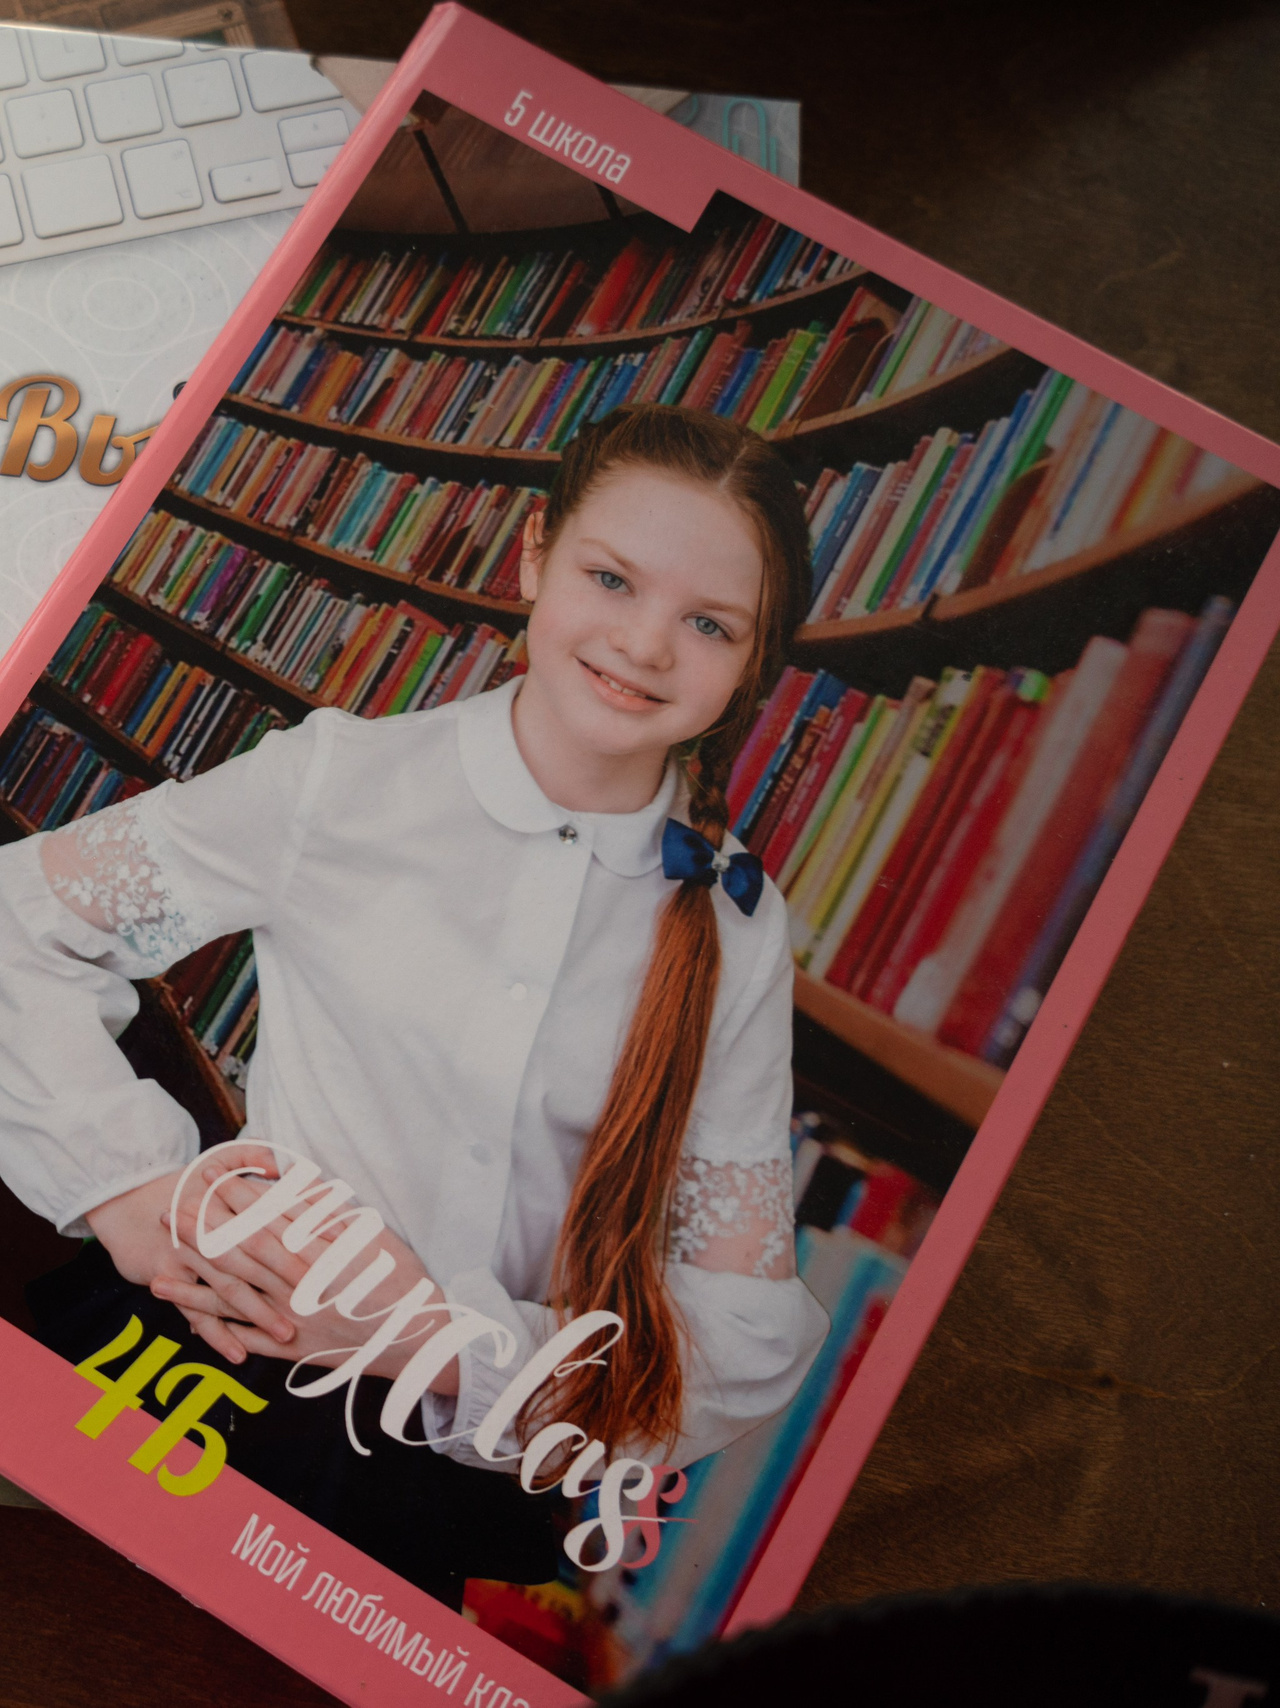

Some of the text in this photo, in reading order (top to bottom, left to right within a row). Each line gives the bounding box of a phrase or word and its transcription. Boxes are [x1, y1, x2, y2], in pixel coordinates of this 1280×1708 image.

[503, 89, 632, 185] 5 школа
[73, 1313, 270, 1497] 4Б
[230, 1512, 531, 1708] Мой любимый кл
